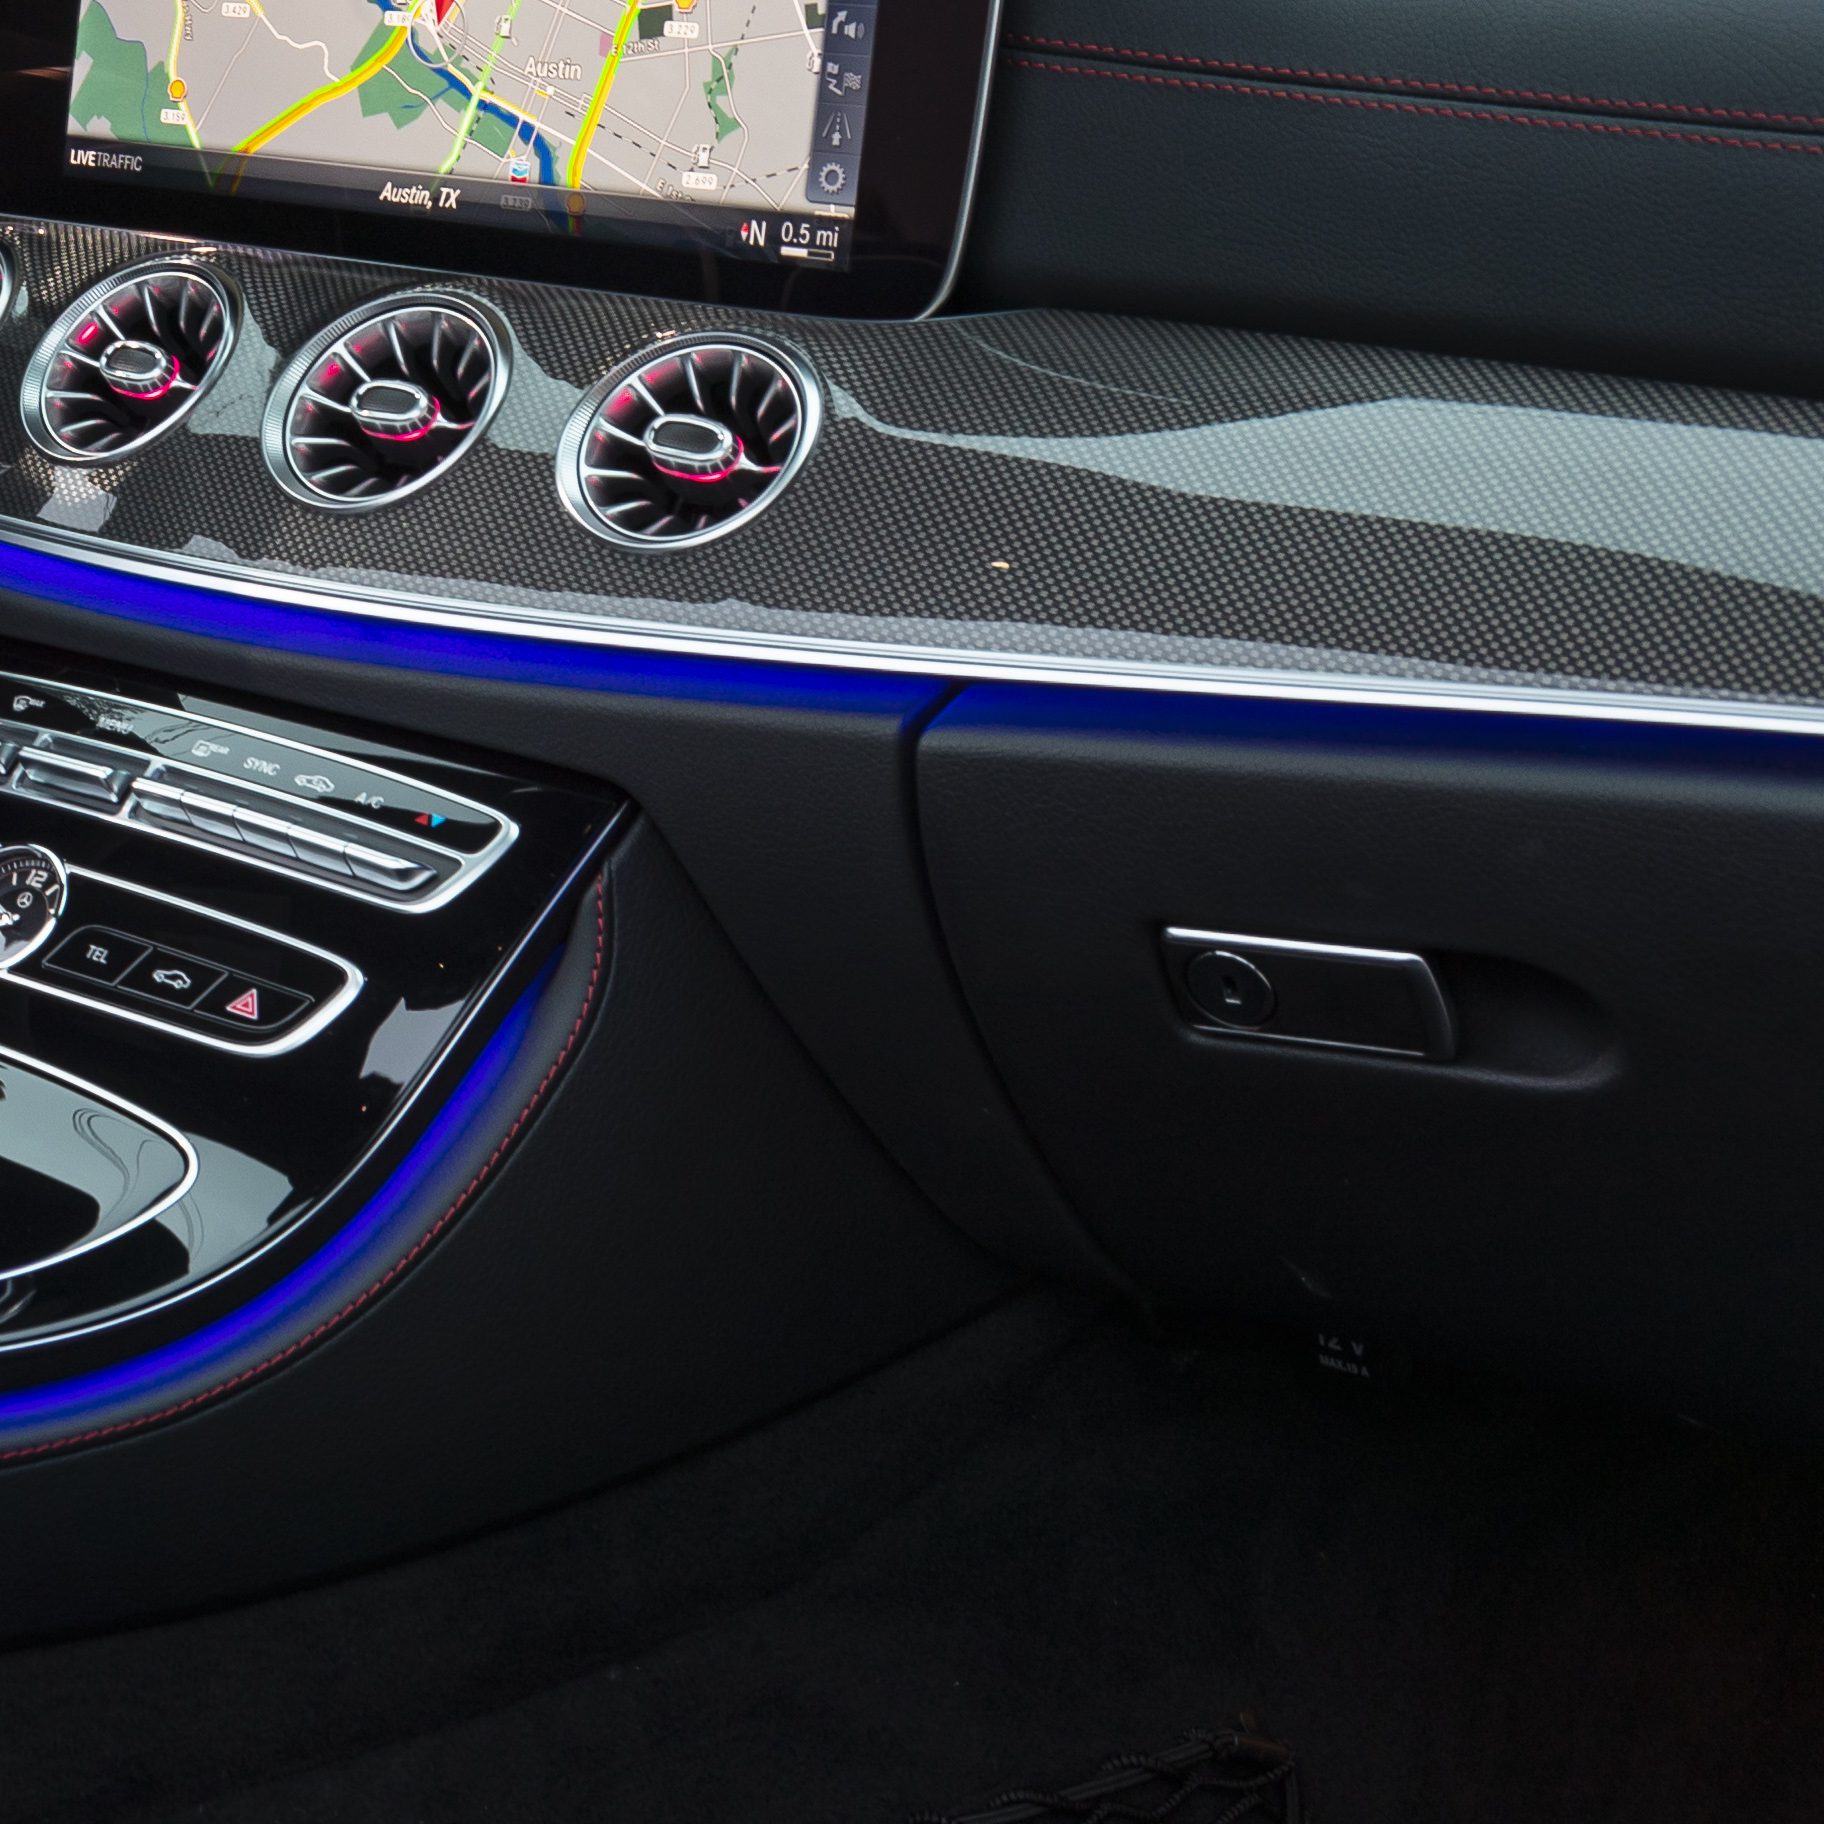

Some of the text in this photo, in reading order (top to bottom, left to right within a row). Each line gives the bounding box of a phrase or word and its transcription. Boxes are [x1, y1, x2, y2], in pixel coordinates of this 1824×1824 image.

[524, 57, 582, 81] Austin
[379, 181, 461, 209] Austin, TX
[749, 221, 839, 248] N 0.5 mi
[243, 757, 281, 776] SYNC
[354, 792, 385, 810] A/C
[25, 868, 49, 889] 12
[84, 944, 110, 965] TEL
